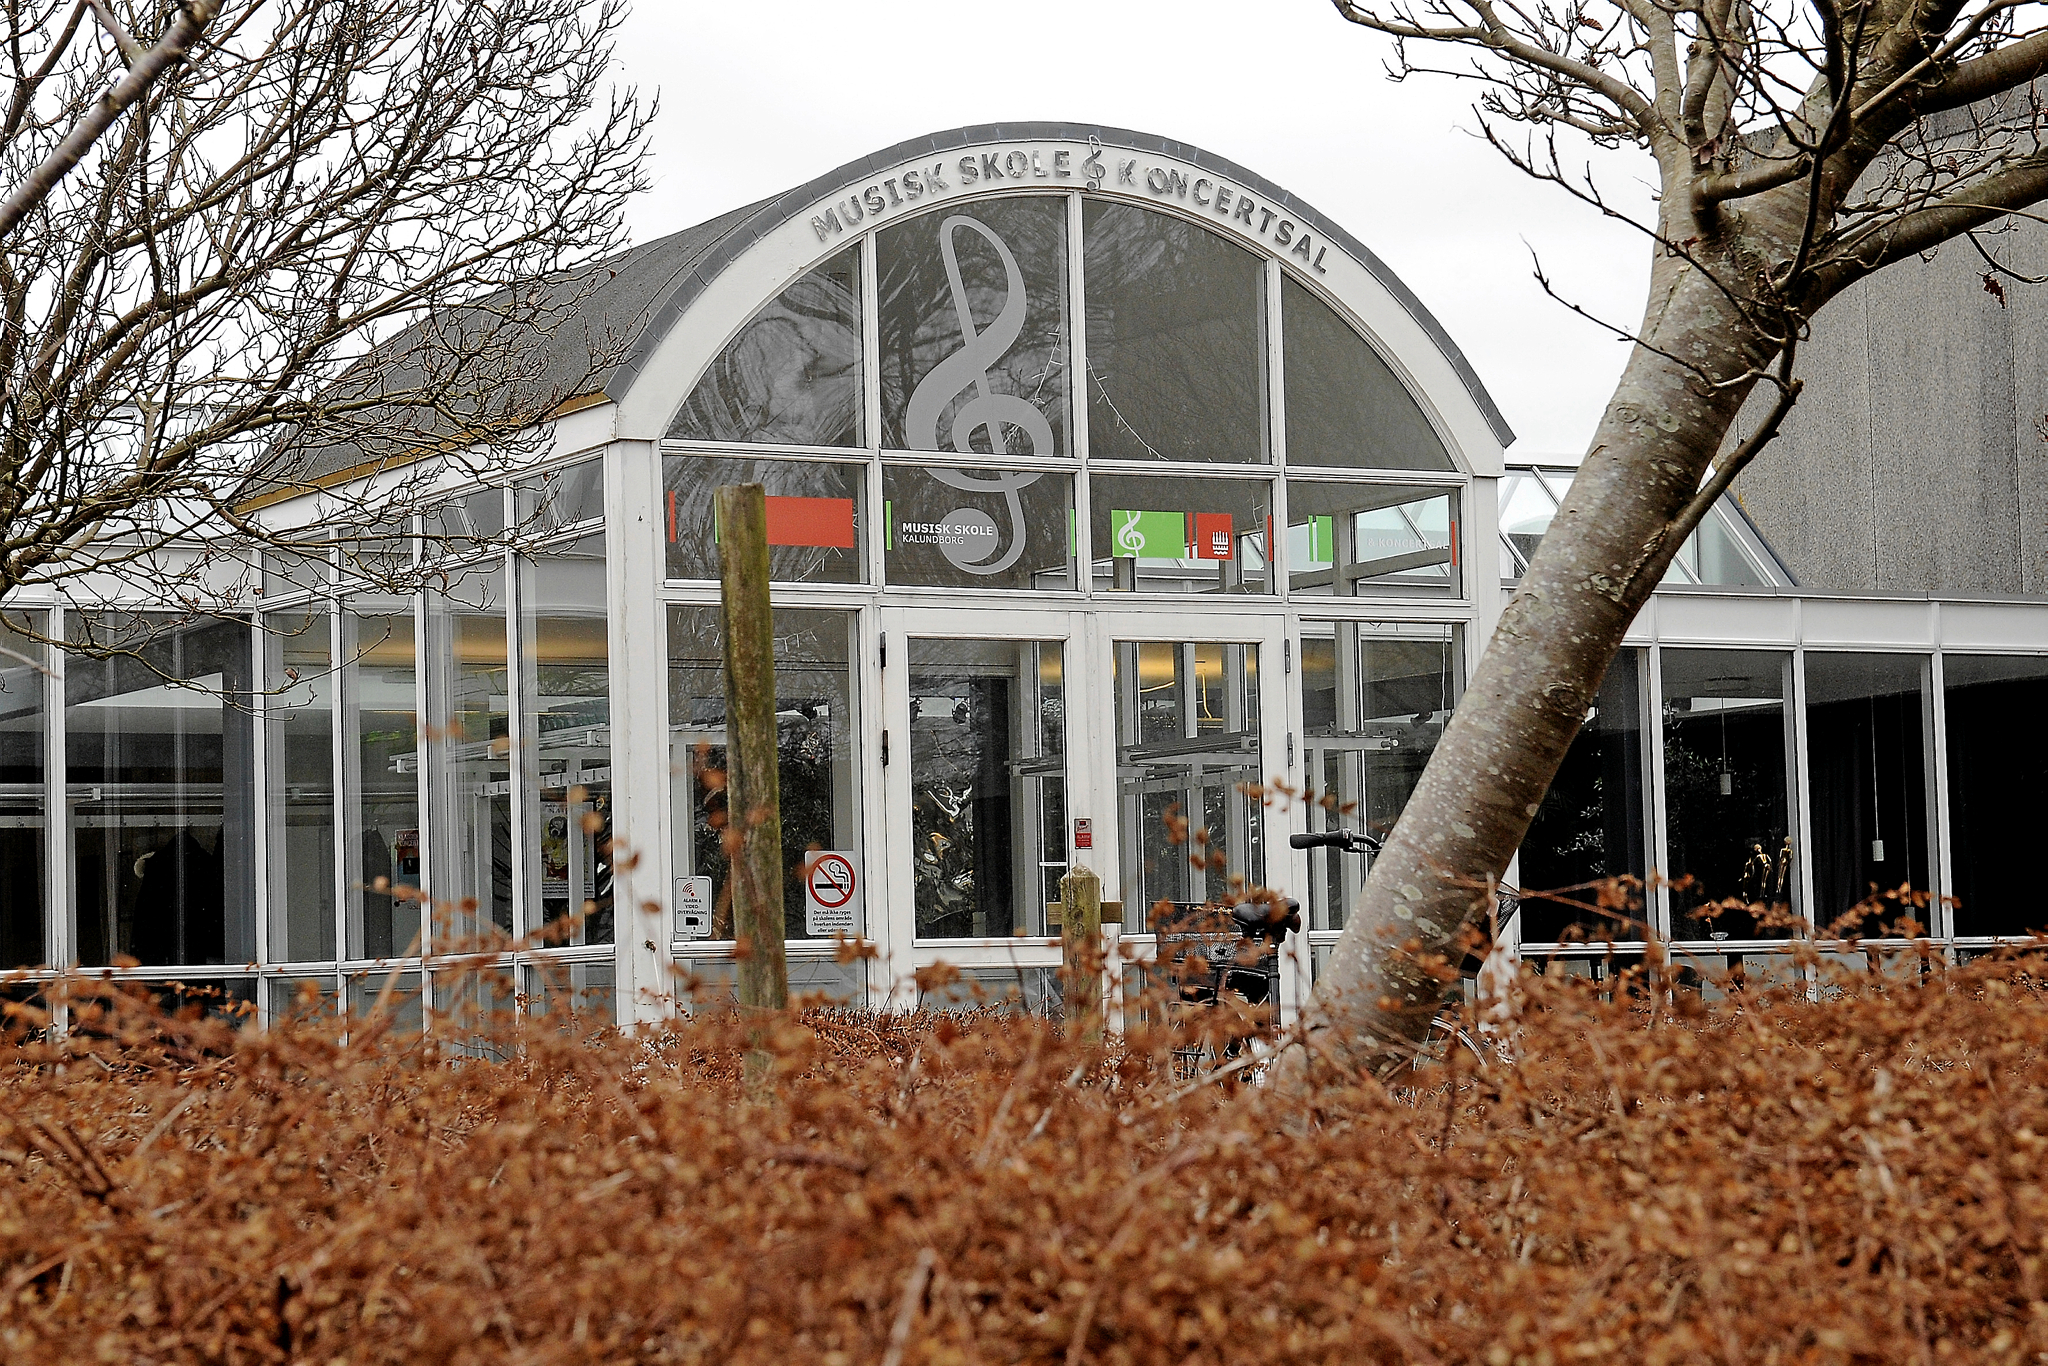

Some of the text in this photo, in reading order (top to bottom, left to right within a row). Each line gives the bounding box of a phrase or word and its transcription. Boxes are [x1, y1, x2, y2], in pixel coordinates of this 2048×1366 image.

[811, 149, 1327, 275] MUSISK SKOLE KONCERTSAL
[902, 522, 993, 536] MUSISK SKOLE
[902, 534, 964, 545] KALUNDBORG
